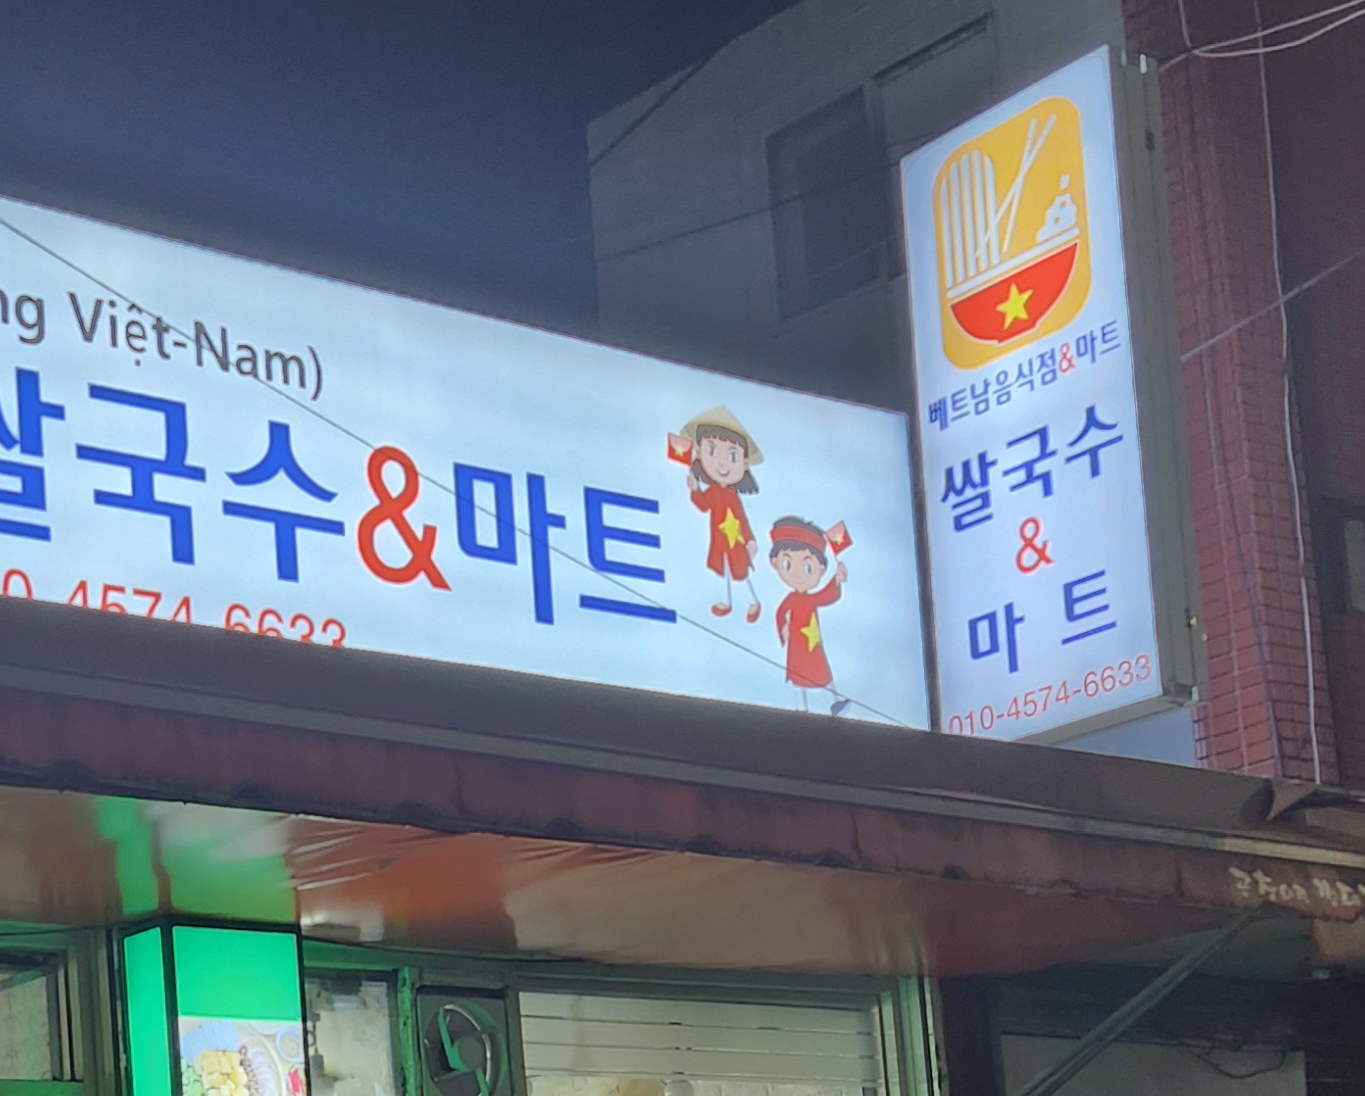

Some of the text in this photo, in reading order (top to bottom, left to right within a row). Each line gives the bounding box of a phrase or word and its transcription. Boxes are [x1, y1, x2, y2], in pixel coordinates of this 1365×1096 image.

[68, 291, 324, 401] Việt-Nam)
[927, 320, 1122, 431] 베트남음식점&마트
[939, 404, 1124, 533] 쌀국수
[1014, 516, 1055, 575] &
[948, 653, 1153, 735] 010-4574-6633
